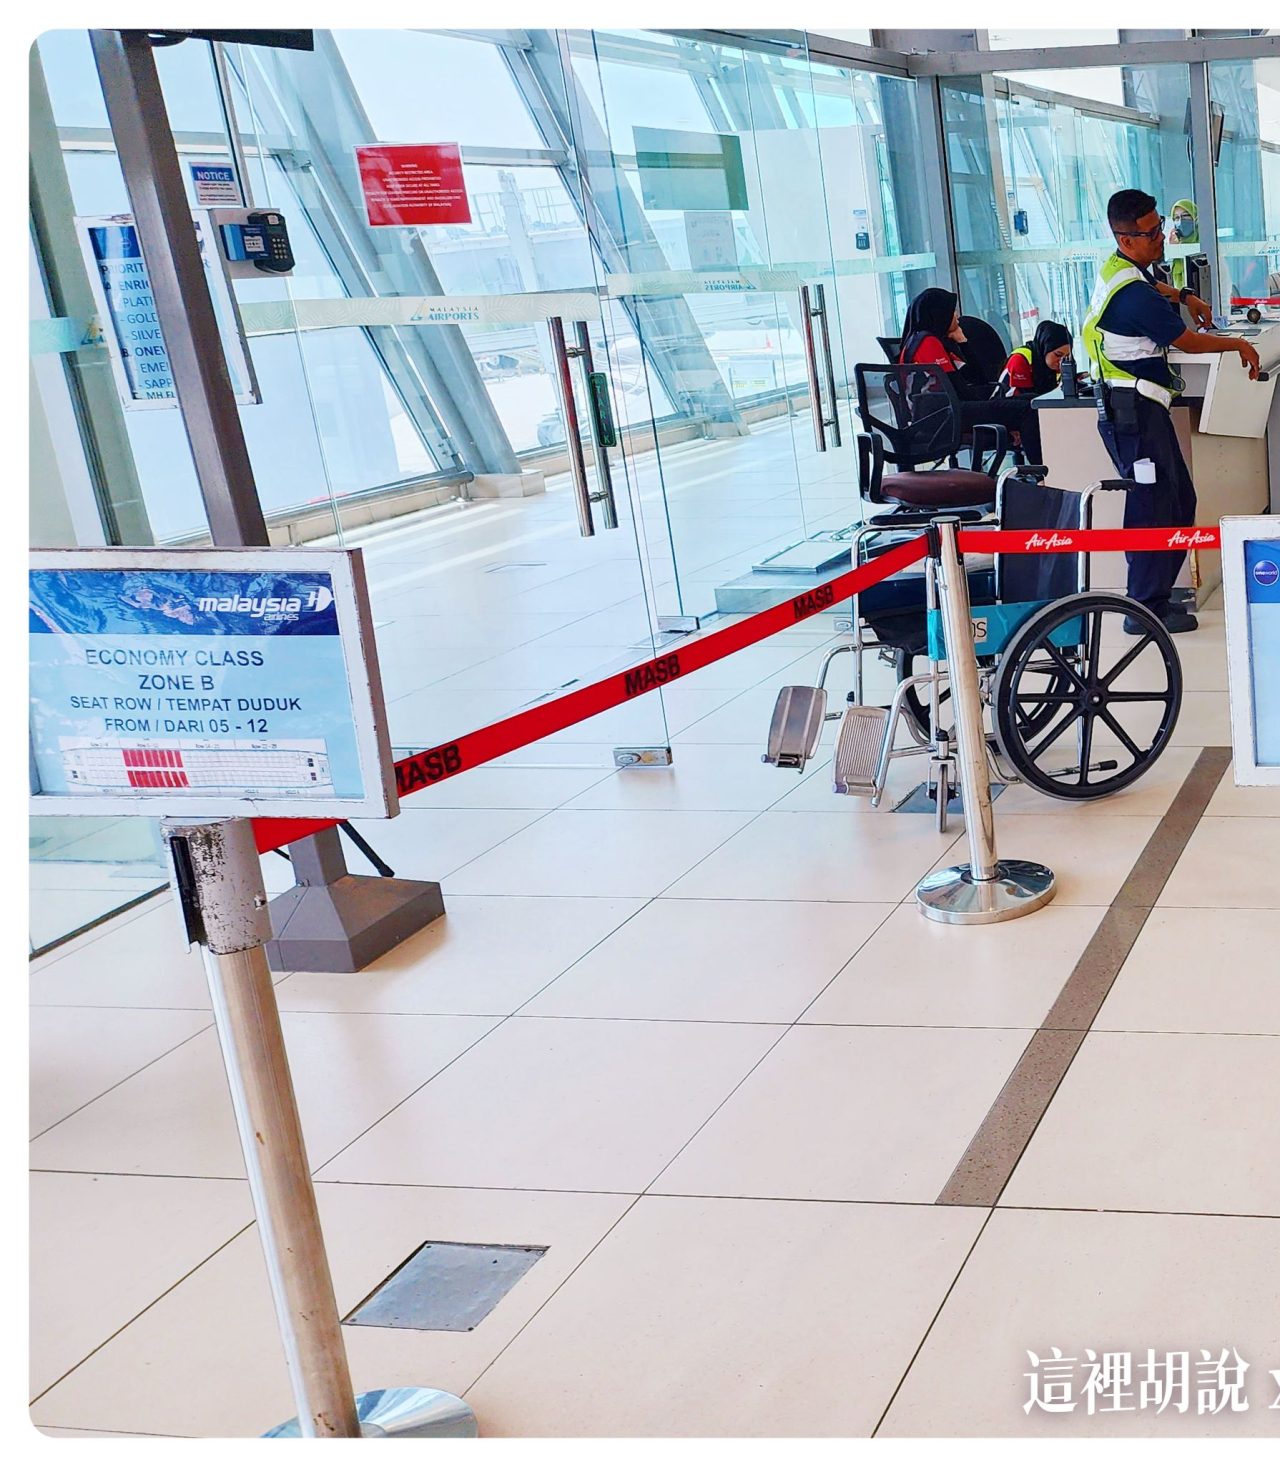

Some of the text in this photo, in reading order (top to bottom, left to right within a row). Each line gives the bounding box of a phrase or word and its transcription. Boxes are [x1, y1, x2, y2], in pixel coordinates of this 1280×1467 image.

[197, 171, 230, 181] NOTICE
[101, 262, 144, 276] PRIORIT
[119, 280, 150, 291] ENRI
[123, 296, 154, 308] PLATI
[428, 312, 479, 321] AIRPORTS
[131, 329, 161, 340] SILVE
[140, 363, 169, 374] EME
[144, 378, 172, 389] SAPP
[1025, 532, 1073, 551] AirAsia
[1167, 529, 1216, 548] AirAsia
[197, 596, 301, 619] malaysia
[793, 584, 835, 621] MASB
[263, 611, 300, 622] airlines
[86, 648, 264, 668] ECONOMY CLASS
[138, 674, 215, 691] ZONE B
[623, 654, 681, 698] MASB
[70, 695, 108, 711] SEAT
[114, 697, 152, 711] ROW
[165, 697, 233, 712] TEMPAT
[237, 697, 302, 712] DUDUK
[104, 718, 151, 732] FROM
[165, 718, 205, 733] DARI
[209, 718, 230, 733] 05
[250, 718, 269, 733] 12
